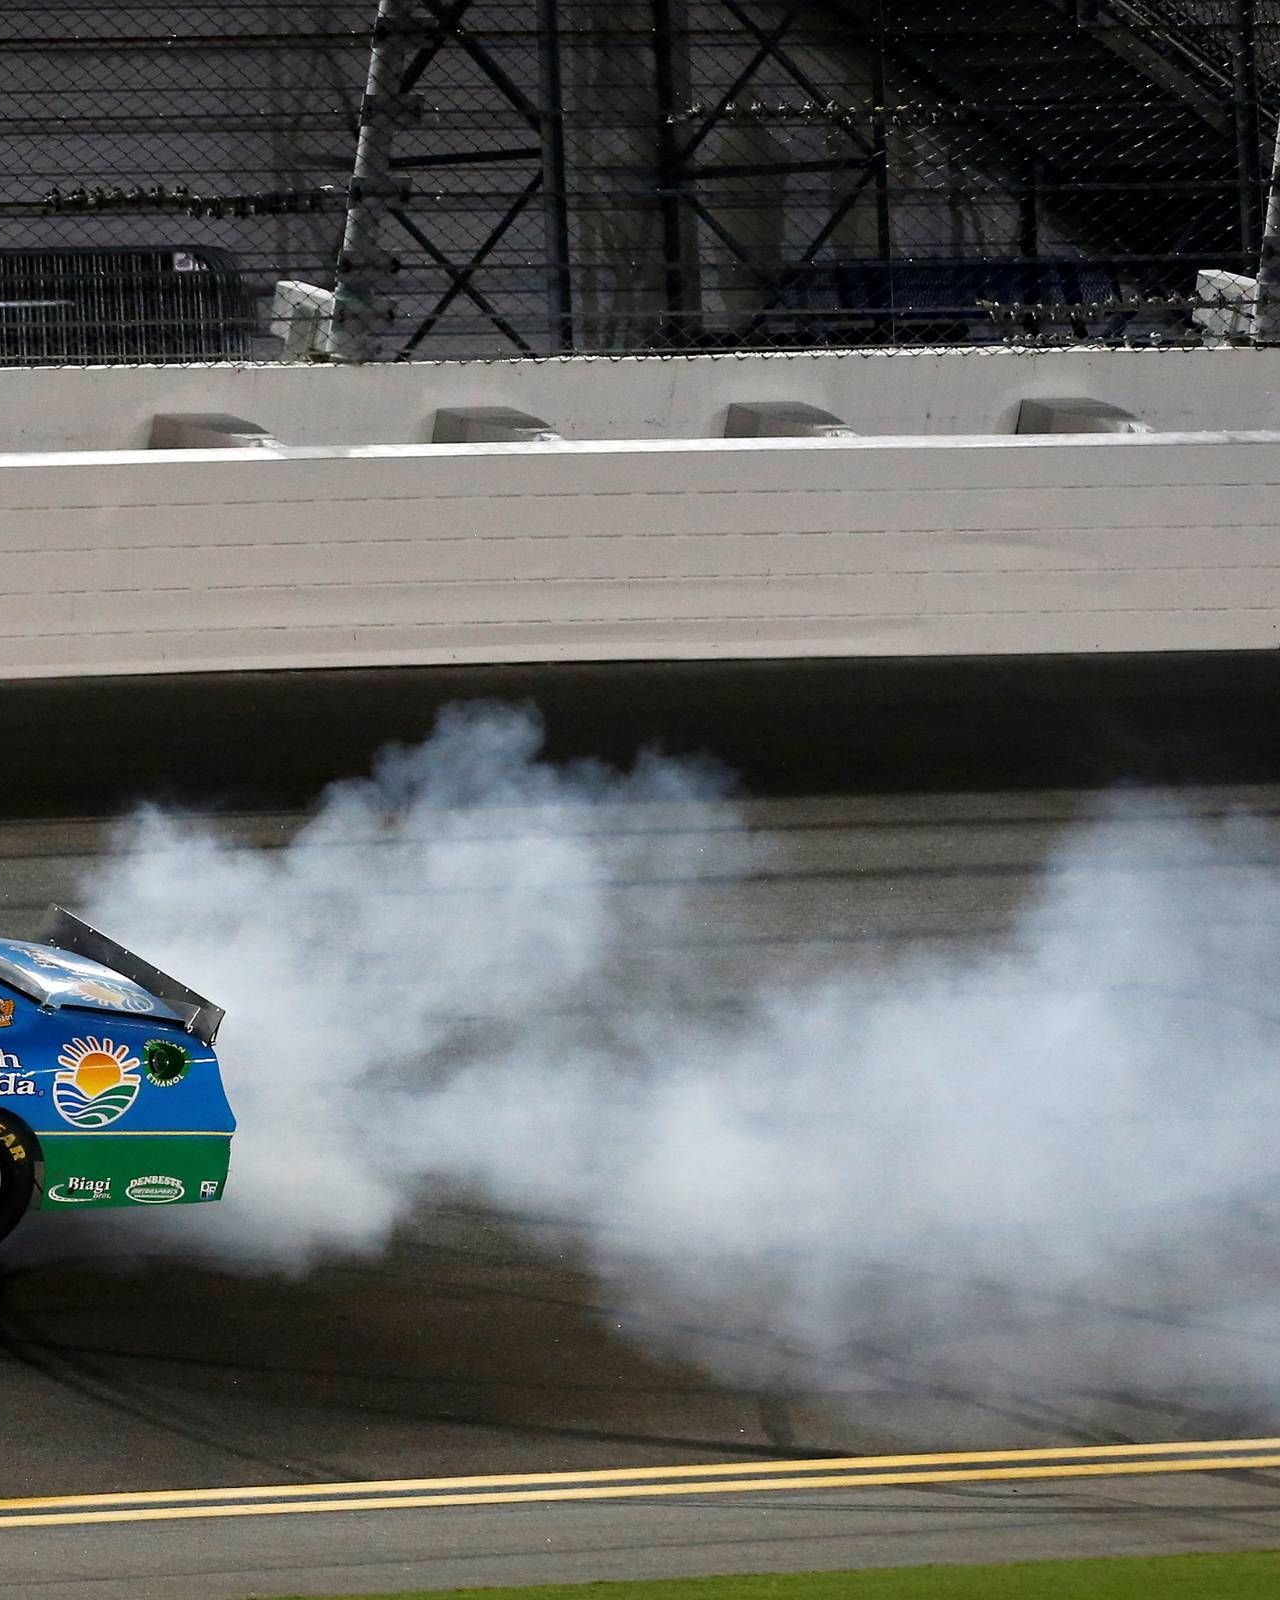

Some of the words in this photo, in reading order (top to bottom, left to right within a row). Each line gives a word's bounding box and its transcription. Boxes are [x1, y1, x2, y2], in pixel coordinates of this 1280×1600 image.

[146, 1072, 185, 1088] ETHANOL
[68, 1176, 111, 1193] Biagi
[130, 1175, 183, 1189] DENBESTE
